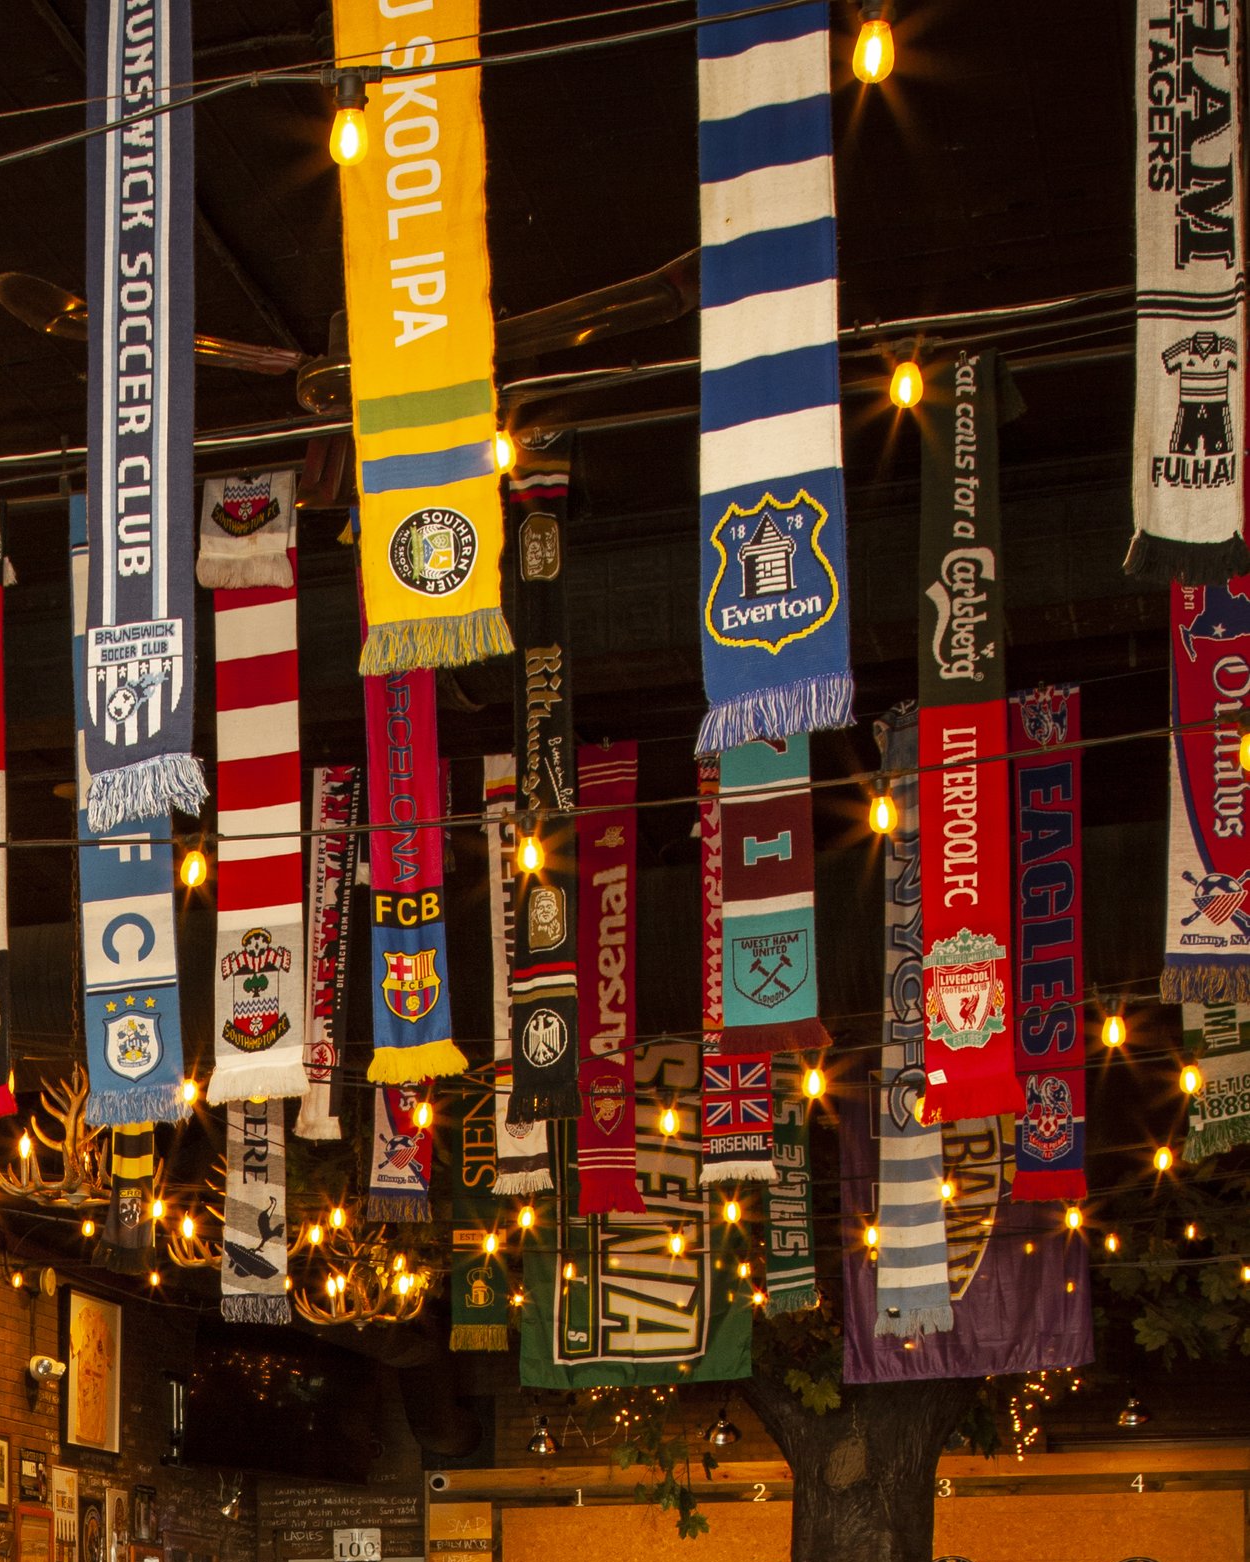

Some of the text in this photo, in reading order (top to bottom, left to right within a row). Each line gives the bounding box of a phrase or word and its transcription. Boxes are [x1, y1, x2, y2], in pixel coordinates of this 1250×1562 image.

[379, 37, 449, 349] SKOOL IPA
[116, 252, 154, 578] SOCCER CLUB
[953, 401, 981, 540] calls for a
[729, 514, 804, 542] 18 78
[422, 511, 472, 592] SOUTHERN TIER
[721, 594, 823, 631] Everton
[926, 546, 997, 683] Carlsberg
[94, 623, 176, 646] BRUNSWICK
[101, 639, 168, 663] SOCCER CLUB
[941, 725, 979, 877] LIVERPOOL
[943, 877, 979, 908] FC
[375, 892, 441, 927] FCB
[1017, 761, 1076, 1058] EAGLES
[741, 933, 800, 950] WEST HAM
[1180, 933, 1228, 947] Albany,
[752, 945, 788, 958] UNITED
[588, 862, 630, 1065] Arsenal
[399, 980, 426, 991] FCB
[939, 970, 990, 986] LIVERPOOL
[941, 984, 972, 994] FOOTBALL
[757, 990, 785, 1004] LONDON
[710, 1135, 767, 1154] ARSENAL
[752, 1482, 767, 1502] 2
[937, 1477, 952, 1498] 3
[1129, 1474, 1145, 1493] 4
[573, 1488, 585, 1507] 1
[283, 1530, 324, 1542] LADIES
[338, 1541, 376, 1558] LOO
